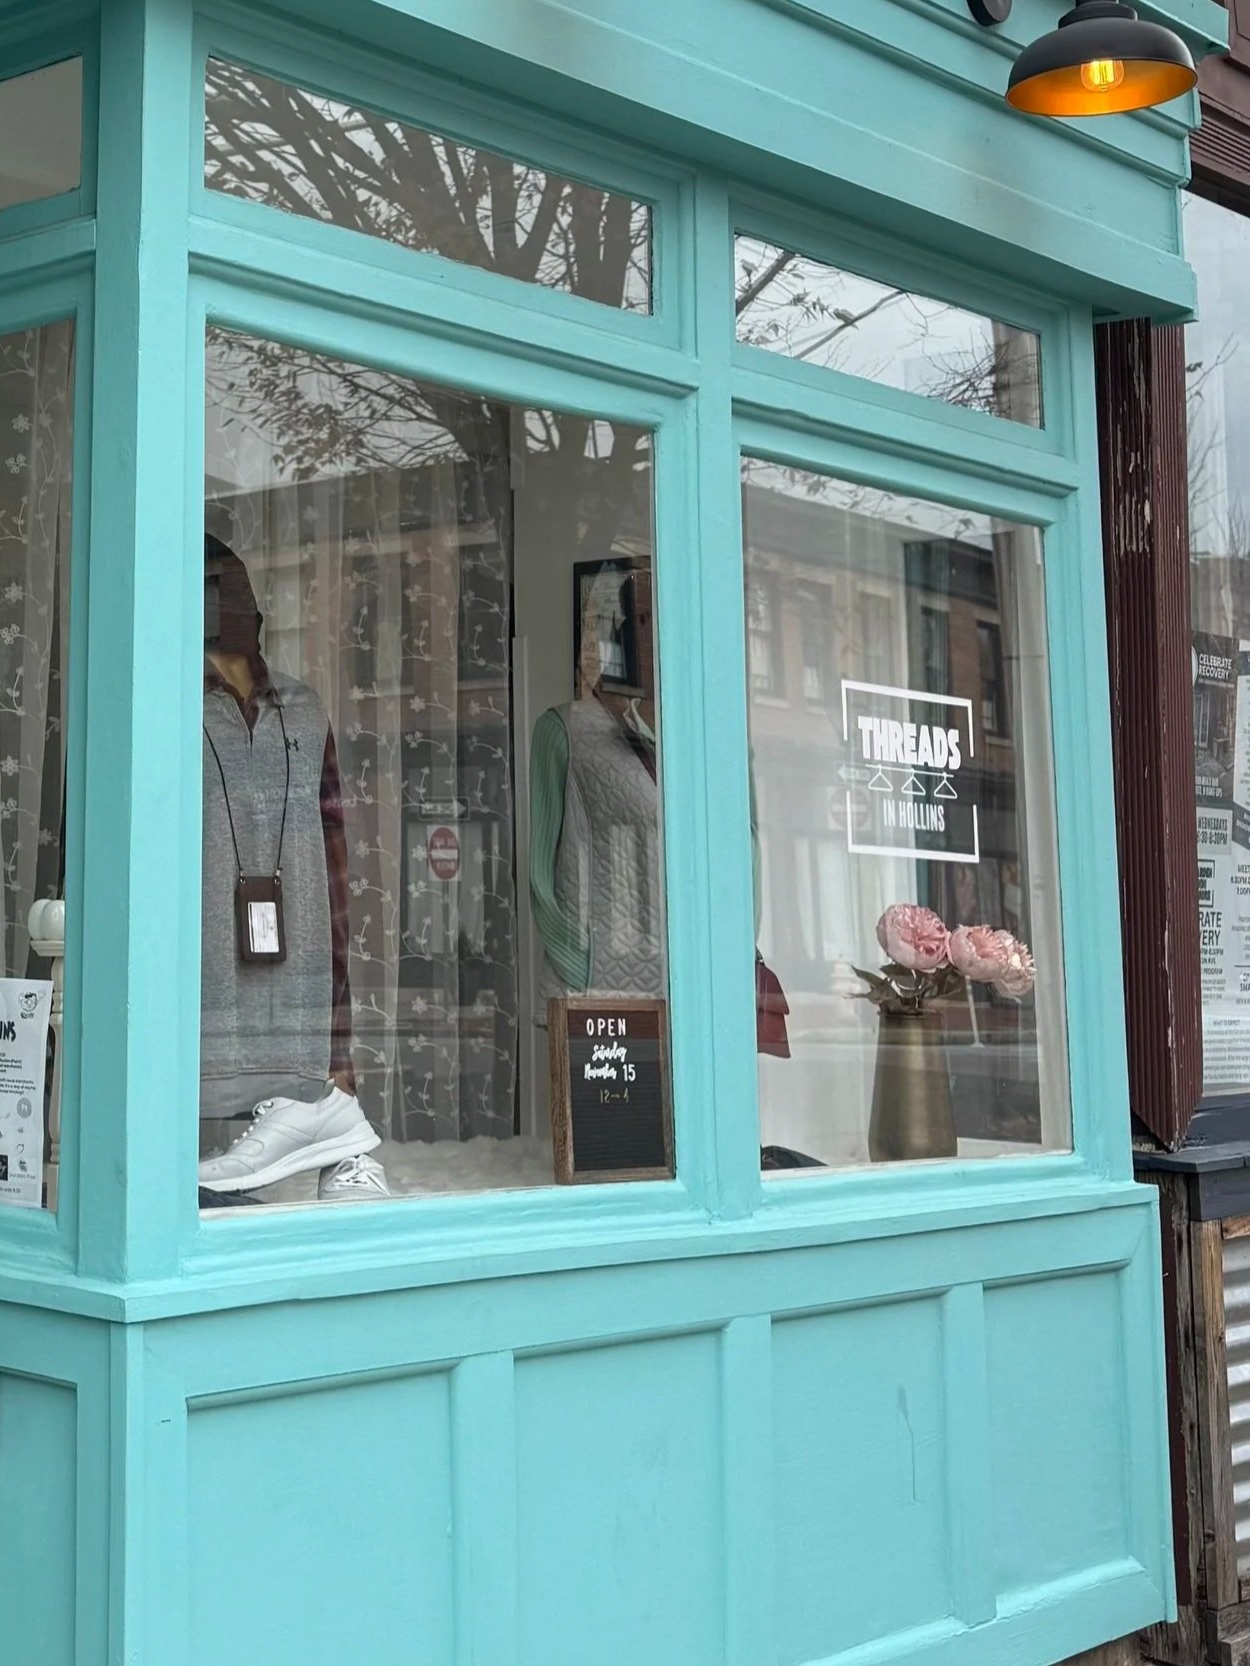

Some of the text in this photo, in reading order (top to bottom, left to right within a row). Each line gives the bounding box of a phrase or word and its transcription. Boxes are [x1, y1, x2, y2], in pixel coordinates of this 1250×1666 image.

[1199, 653, 1233, 670] CELEBRATE
[1199, 664, 1230, 680] RECOVERY
[857, 715, 962, 770] THREADS
[883, 799, 945, 832] IN HOLLINS
[586, 1018, 627, 1037] OPEN
[622, 1064, 636, 1082] 15
